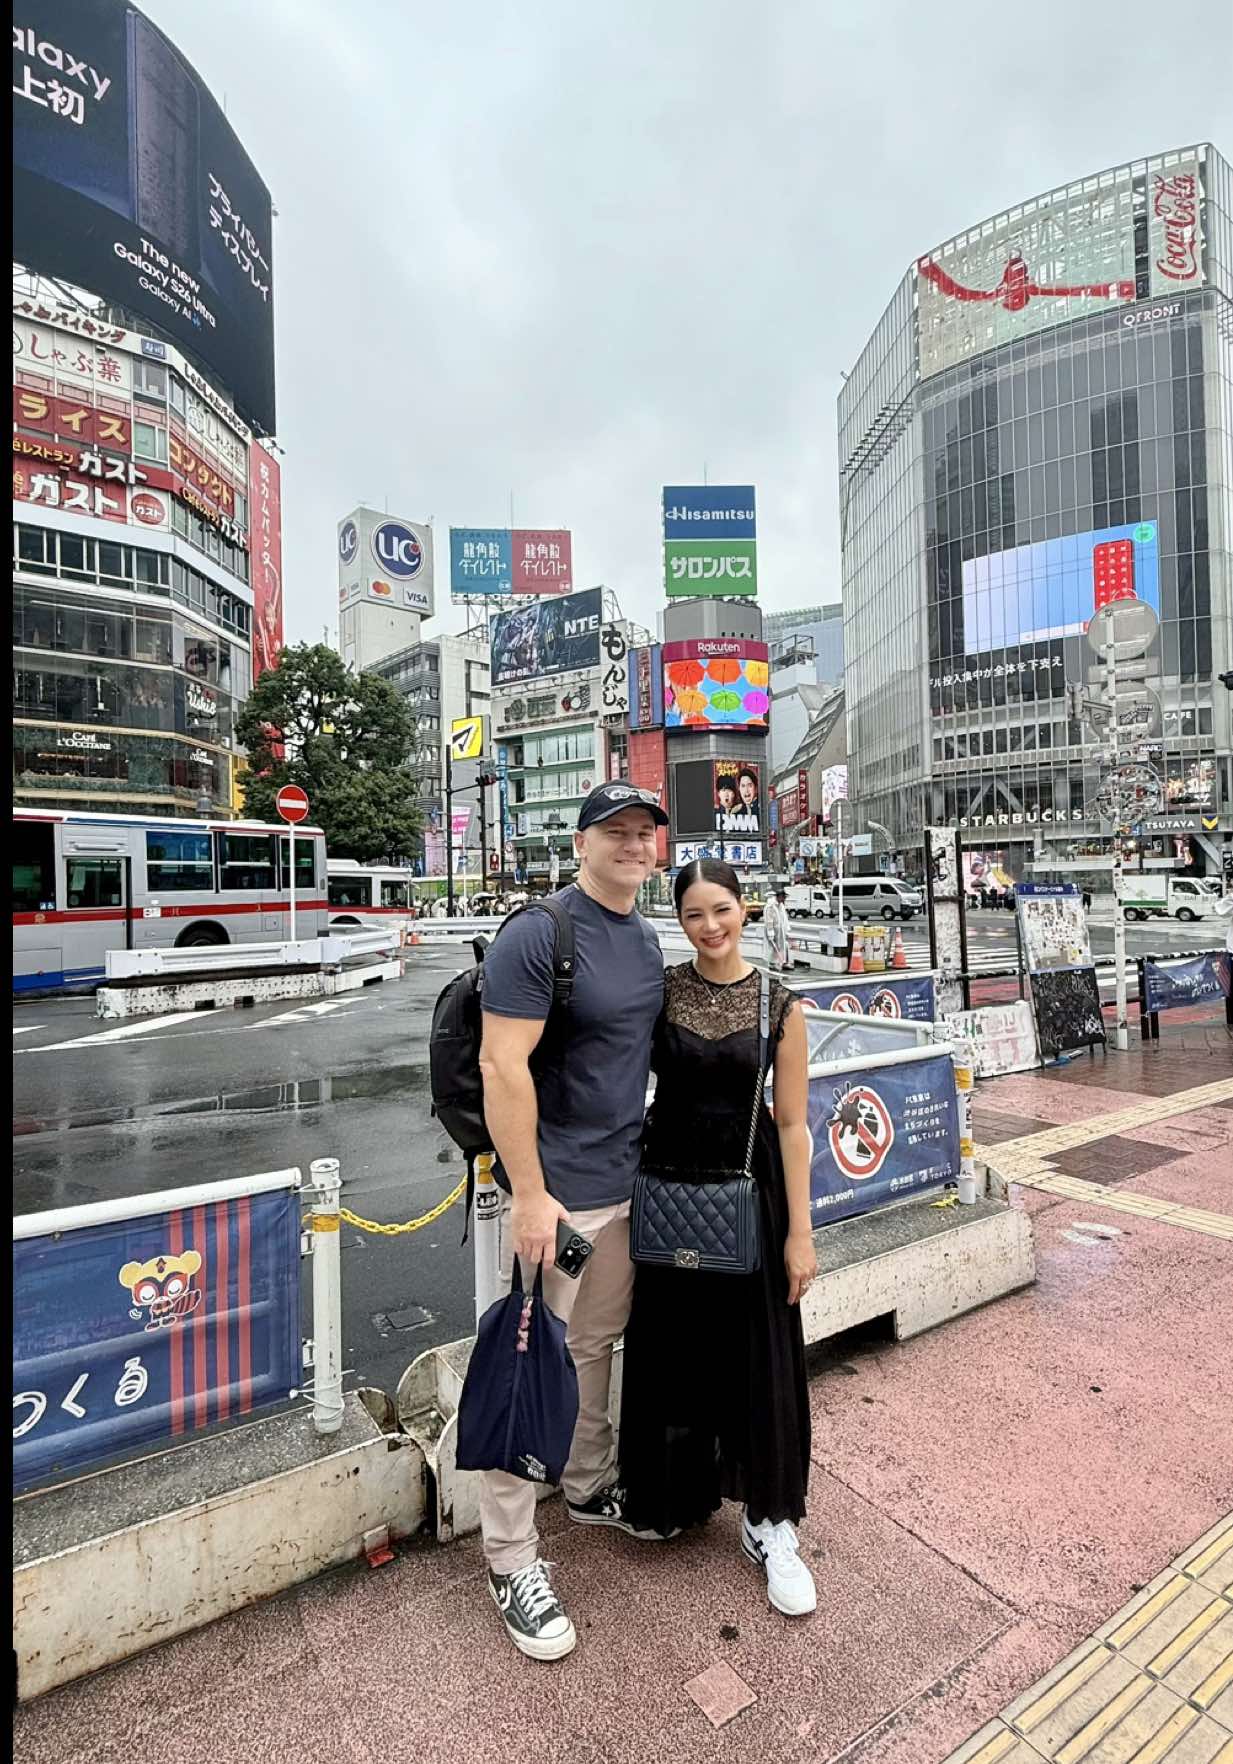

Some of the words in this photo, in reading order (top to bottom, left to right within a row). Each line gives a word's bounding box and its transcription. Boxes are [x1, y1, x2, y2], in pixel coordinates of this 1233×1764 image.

[1154, 173, 1199, 281] Coca-Cola
[140, 237, 169, 268] The
[172, 263, 200, 294] new
[113, 242, 169, 288] Galaxy
[170, 278, 191, 303] S26
[192, 295, 216, 328] Ultra
[138, 276, 181, 313] Galaxy
[1123, 303, 1182, 327] QFRONT
[19, 393, 128, 444] ライス
[79, 450, 148, 484] ガスト
[170, 439, 233, 507] コンタクト
[29, 473, 119, 516] ガスト
[135, 505, 162, 519] ガスト
[378, 531, 420, 568] UC
[670, 556, 753, 579] サロンパス
[406, 591, 428, 605] VISA
[564, 614, 600, 637] NTE
[697, 642, 742, 653] Rakuten
[601, 622, 628, 710] もんじゃ
[959, 808, 1084, 828] STARBUCKS
[1145, 820, 1195, 830] TSUTAYA
